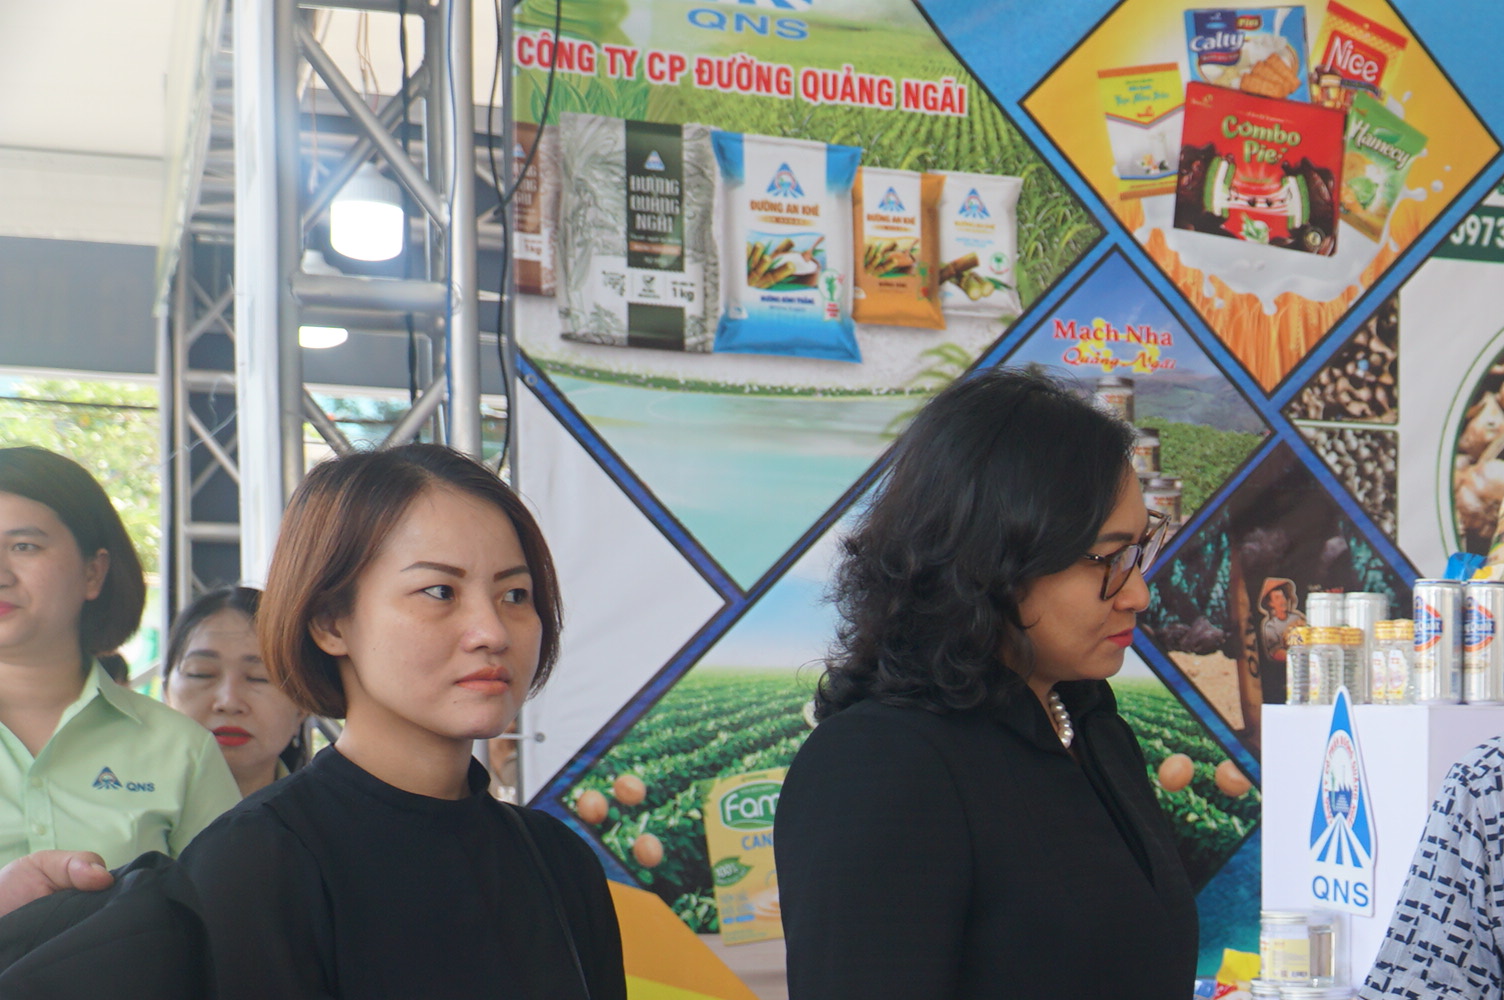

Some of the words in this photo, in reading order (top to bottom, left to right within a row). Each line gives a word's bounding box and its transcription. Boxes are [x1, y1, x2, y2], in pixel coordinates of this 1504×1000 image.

[686, 9, 809, 40] QNS
[1190, 30, 1244, 52] Calty
[1324, 36, 1379, 83] Nice
[517, 33, 595, 73] CÔNG
[605, 46, 638, 79] TY
[647, 52, 686, 84] CP
[696, 56, 793, 97] ĐƯỜNG
[802, 63, 894, 108] QUẢNG
[904, 76, 968, 115] NGÃI
[1222, 115, 1301, 147] Combo
[1243, 139, 1277, 164] Pie
[1125, 324, 1174, 347] Nha
[126, 781, 156, 793] QNS
[725, 795, 778, 822] Fam
[742, 834, 773, 851] CAN
[1312, 875, 1369, 908] QNS
